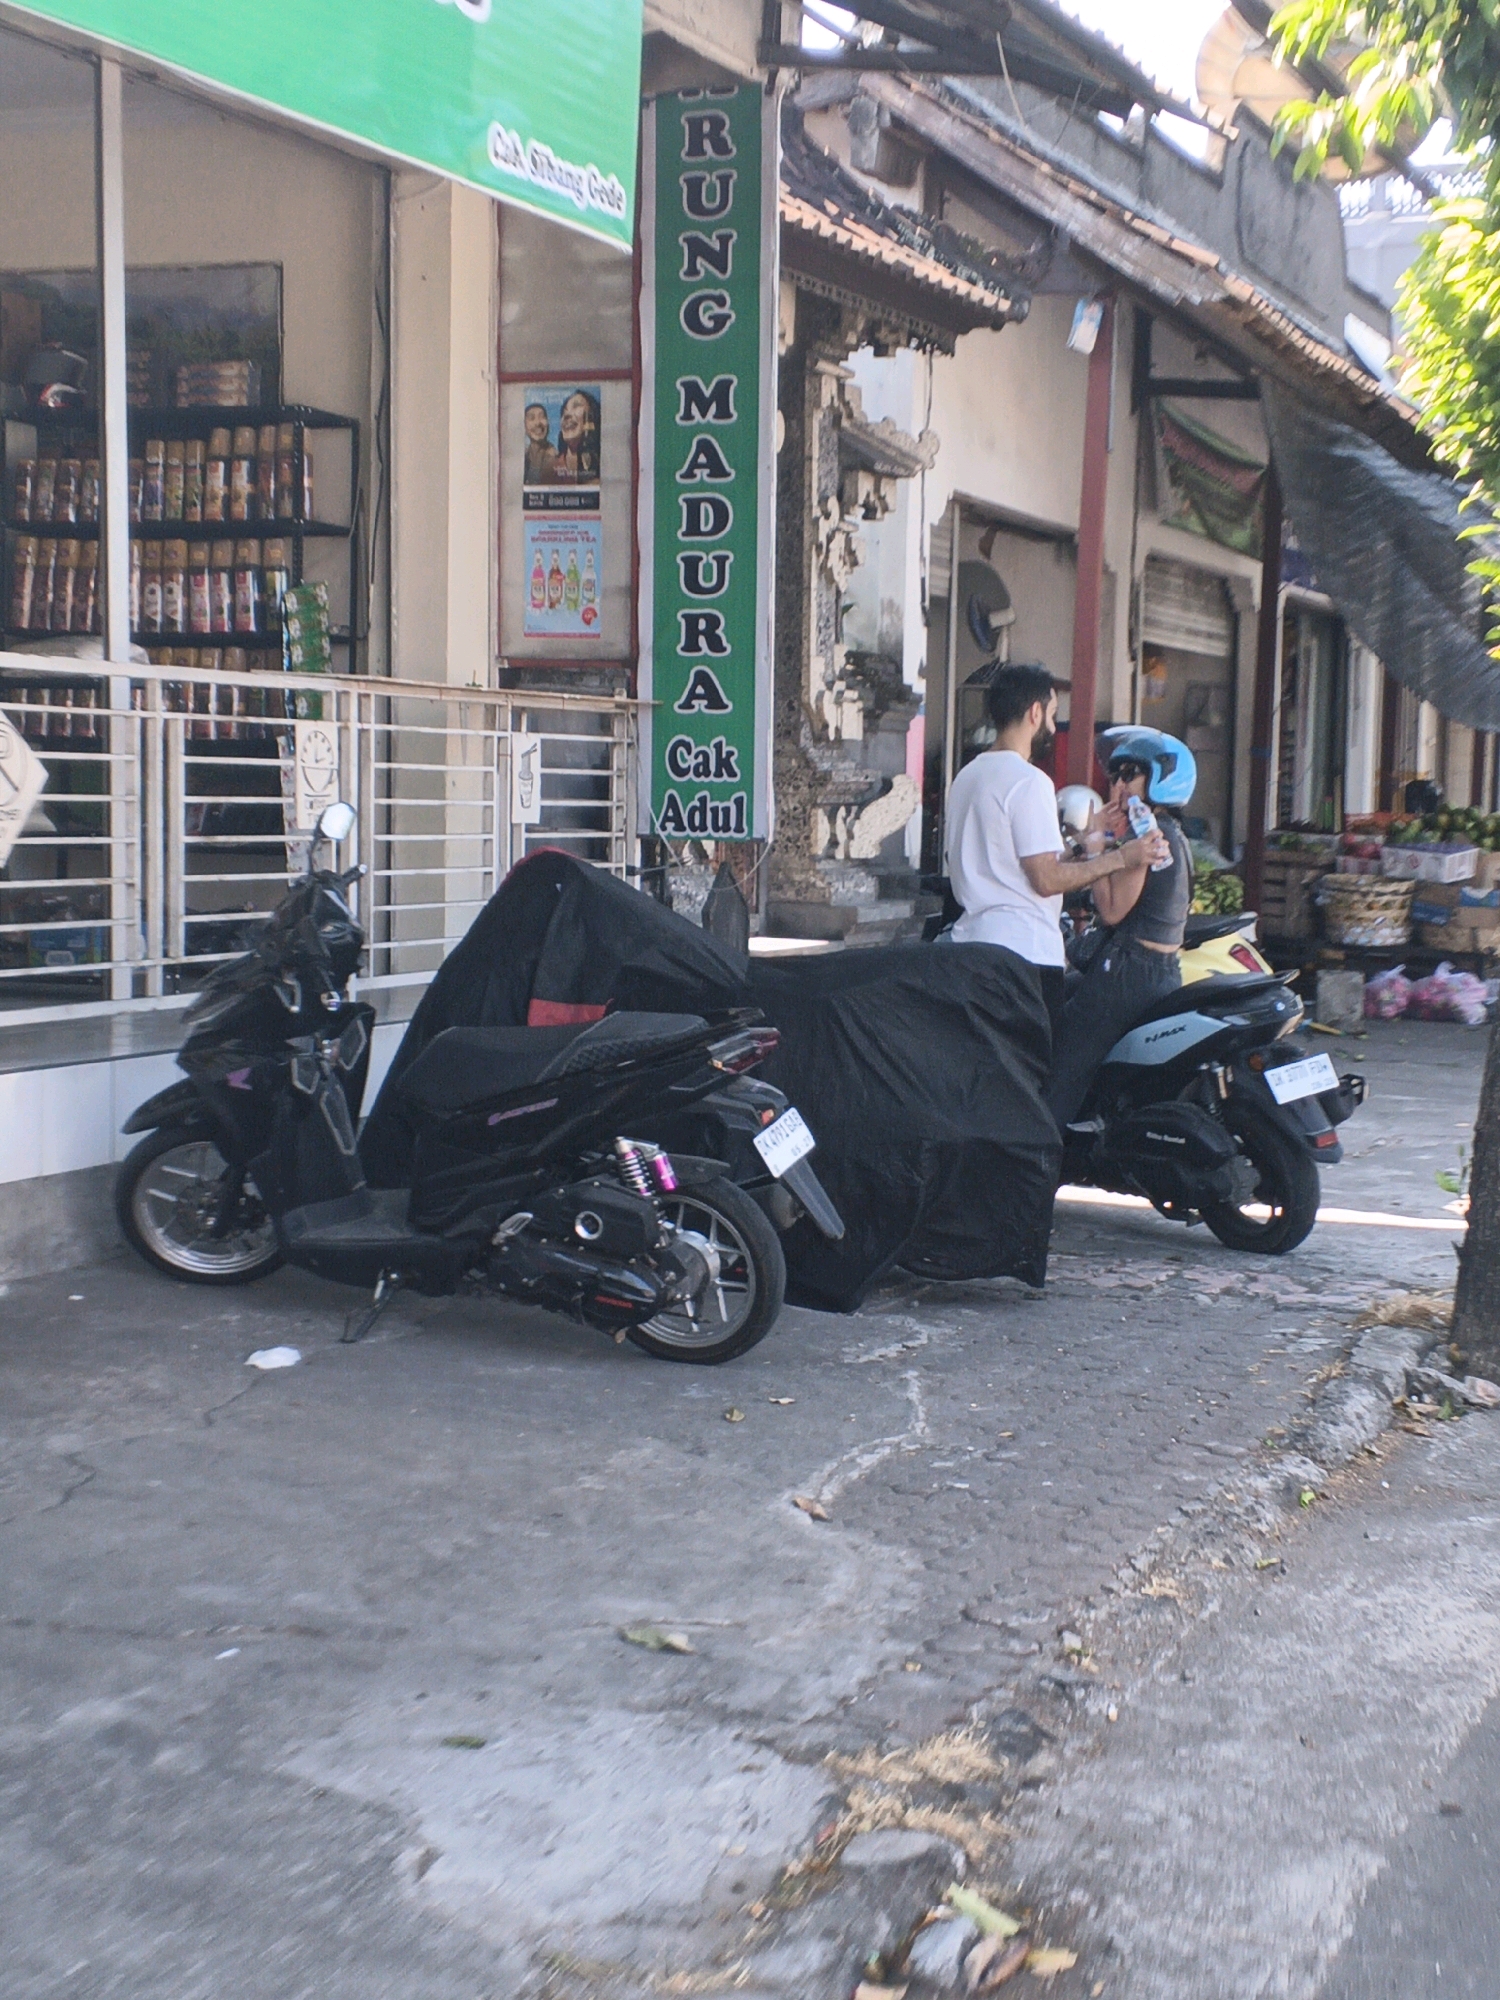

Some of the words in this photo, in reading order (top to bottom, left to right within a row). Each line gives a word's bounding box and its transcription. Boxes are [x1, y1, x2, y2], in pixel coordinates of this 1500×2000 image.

[680, 86, 737, 339] RUNG
[674, 376, 737, 713] MADURA
[659, 789, 747, 838] Adul
[666, 735, 740, 781] Cak
